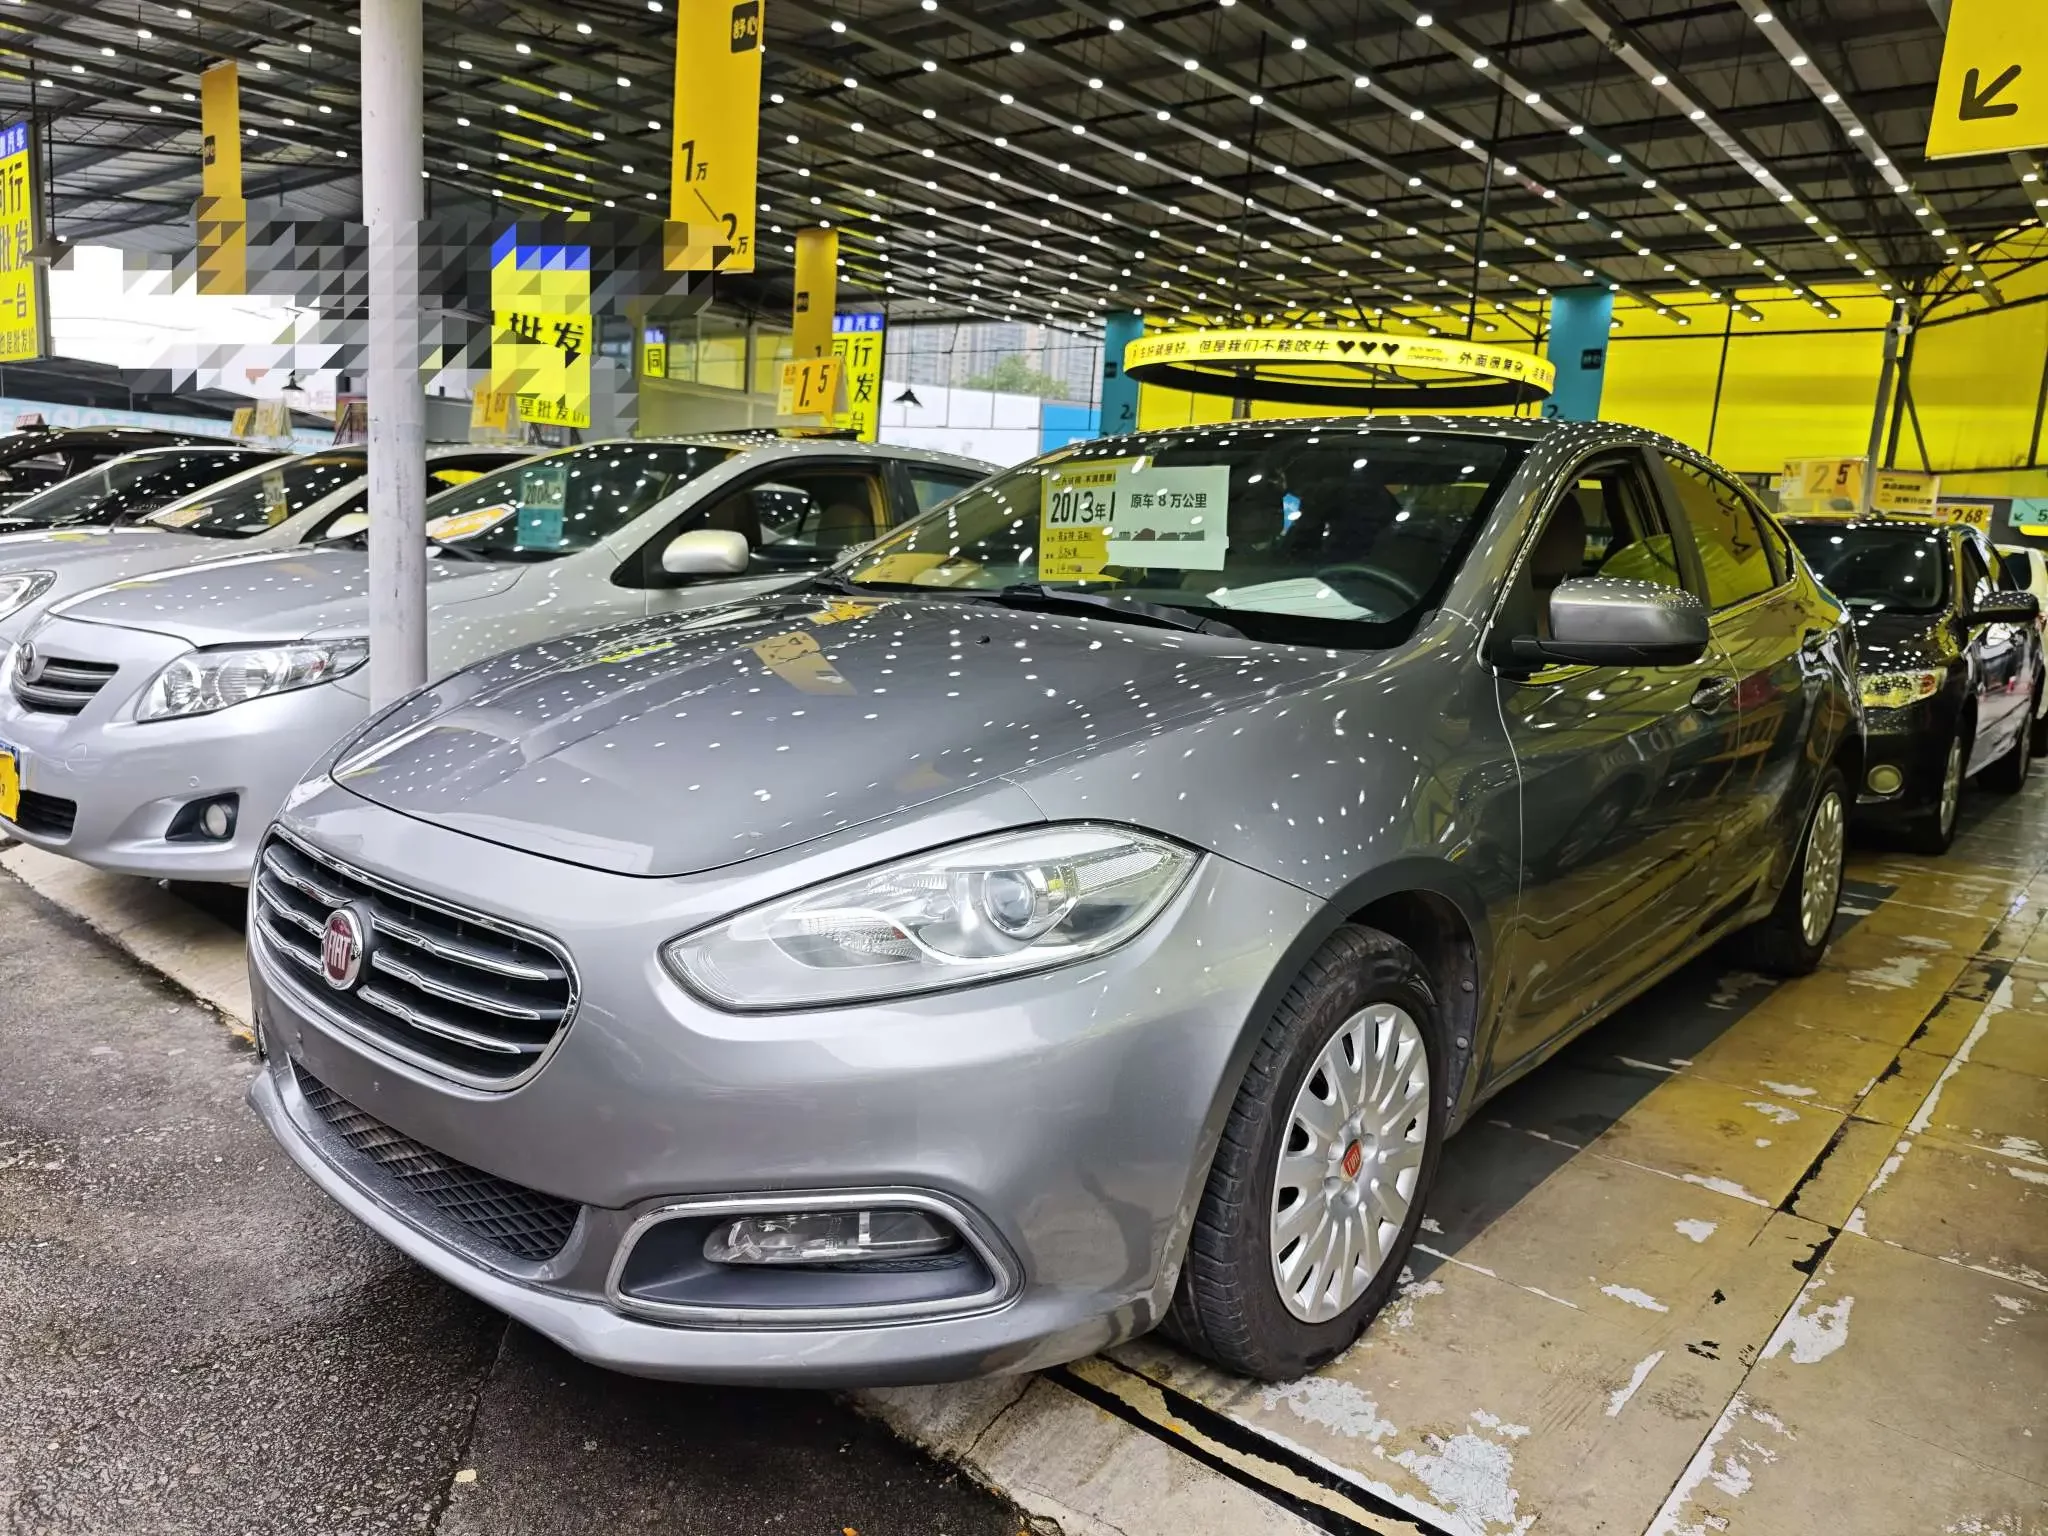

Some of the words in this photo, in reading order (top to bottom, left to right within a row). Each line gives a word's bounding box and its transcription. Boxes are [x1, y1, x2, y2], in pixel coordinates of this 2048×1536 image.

[733, 17, 757, 39] 舒心
[510, 313, 584, 354] 批发
[799, 365, 831, 407] 1.5
[327, 930, 352, 971] FIAT
